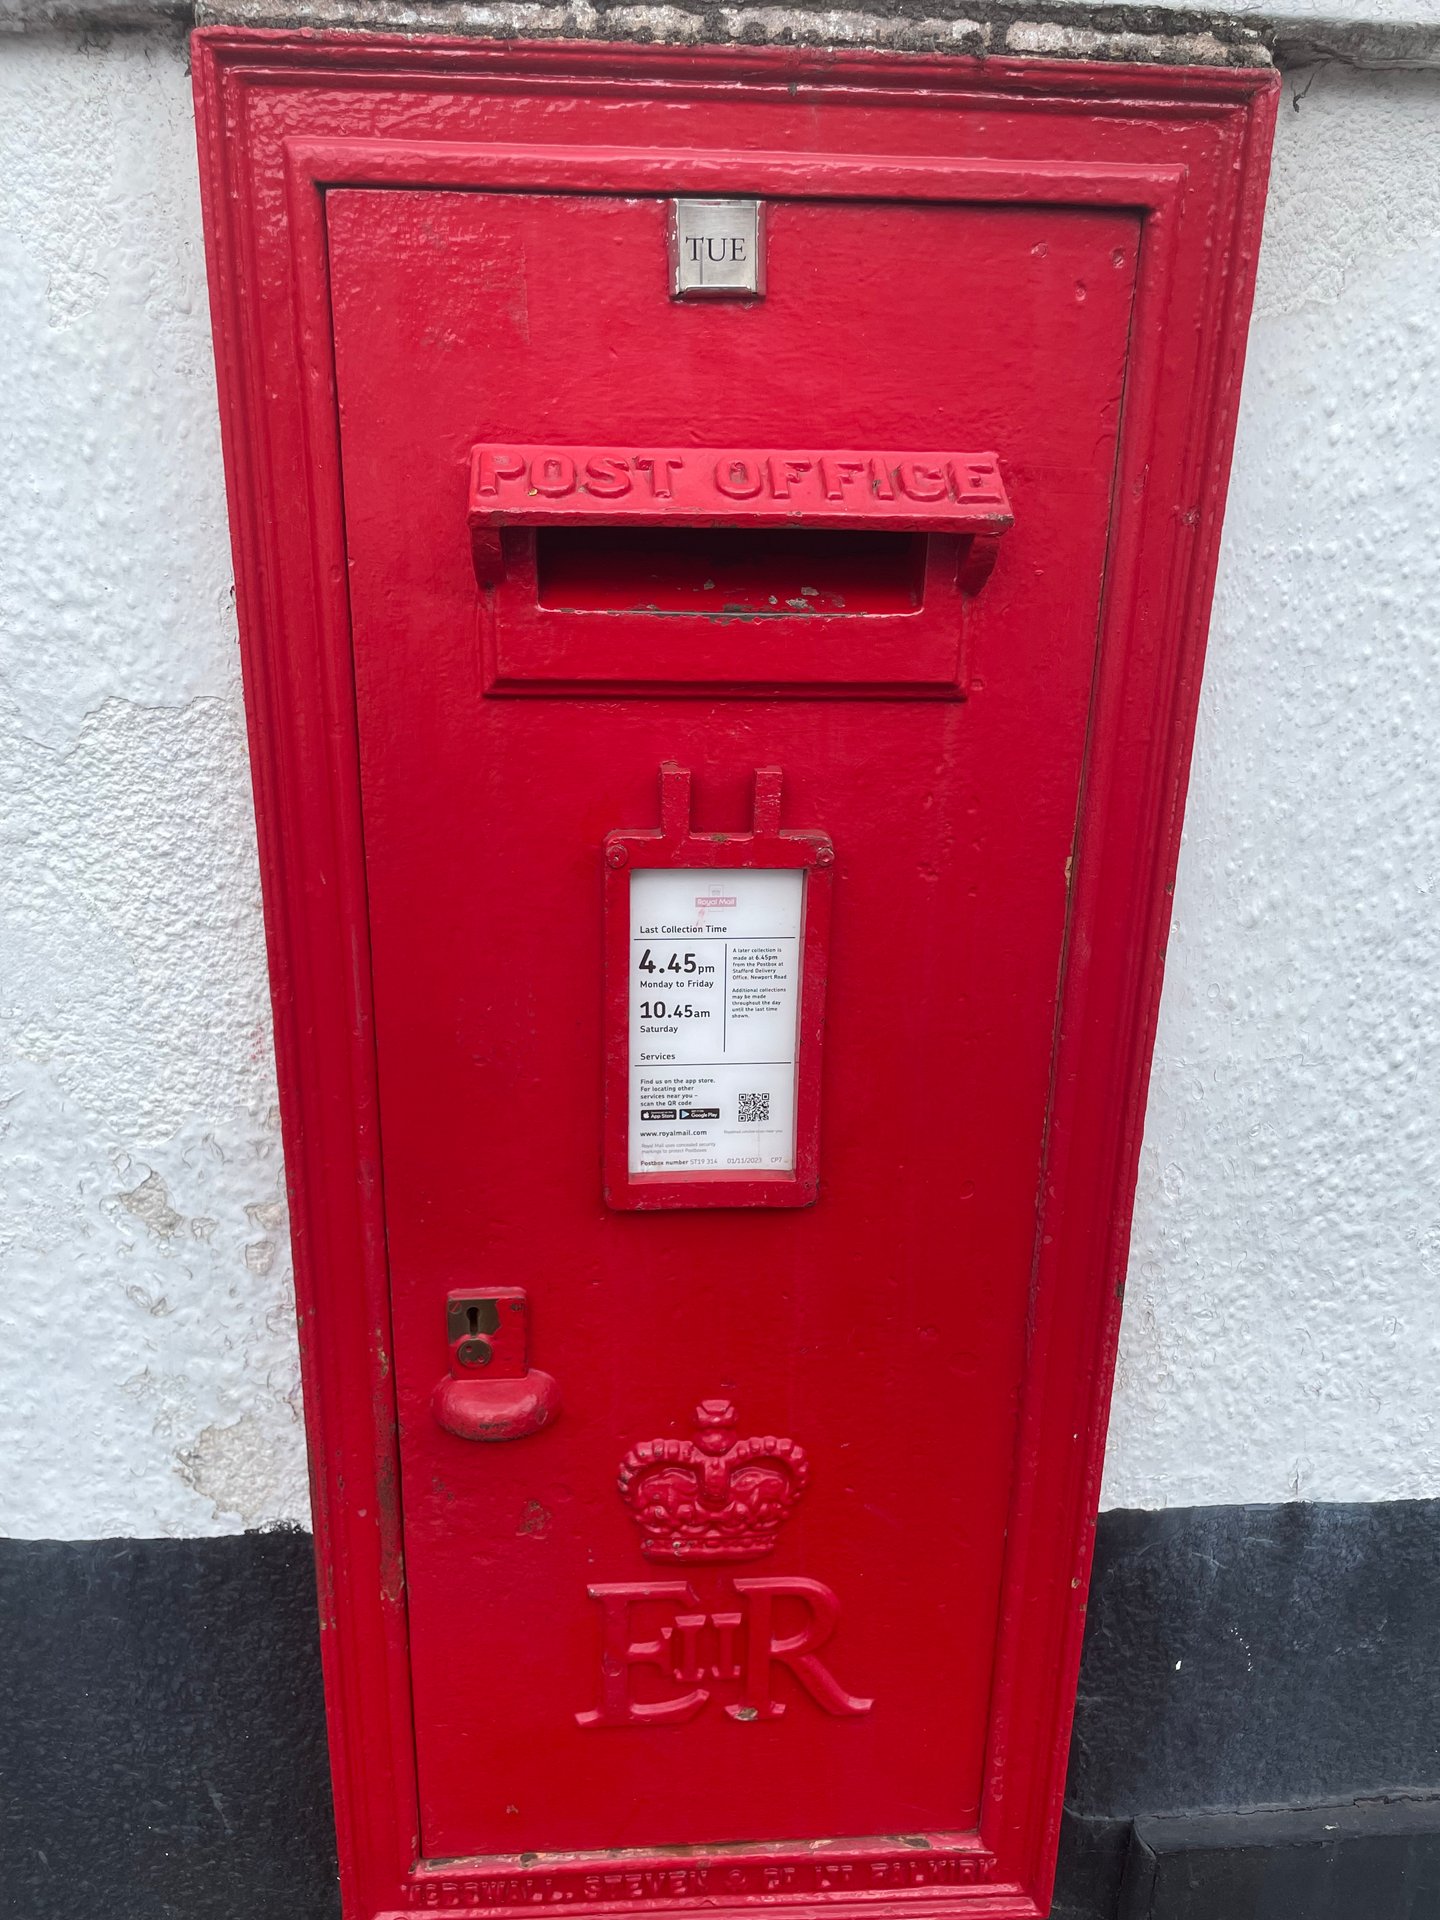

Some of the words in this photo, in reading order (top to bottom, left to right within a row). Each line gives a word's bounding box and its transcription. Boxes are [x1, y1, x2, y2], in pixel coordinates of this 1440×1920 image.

[685, 236, 747, 262] TUE
[476, 449, 683, 499] POST
[714, 453, 1003, 505] OFFICE
[698, 898, 718, 906] Royal
[661, 926, 703, 934] Collection
[706, 925, 728, 933] Time
[638, 949, 715, 975] 4.45pm
[640, 981, 673, 990] Monday
[688, 980, 714, 988] Friday
[640, 1001, 711, 1018] 10.45am
[640, 1025, 678, 1034] Saturday
[640, 1052, 676, 1060] Services
[584, 1870, 708, 1900] STEVEN
